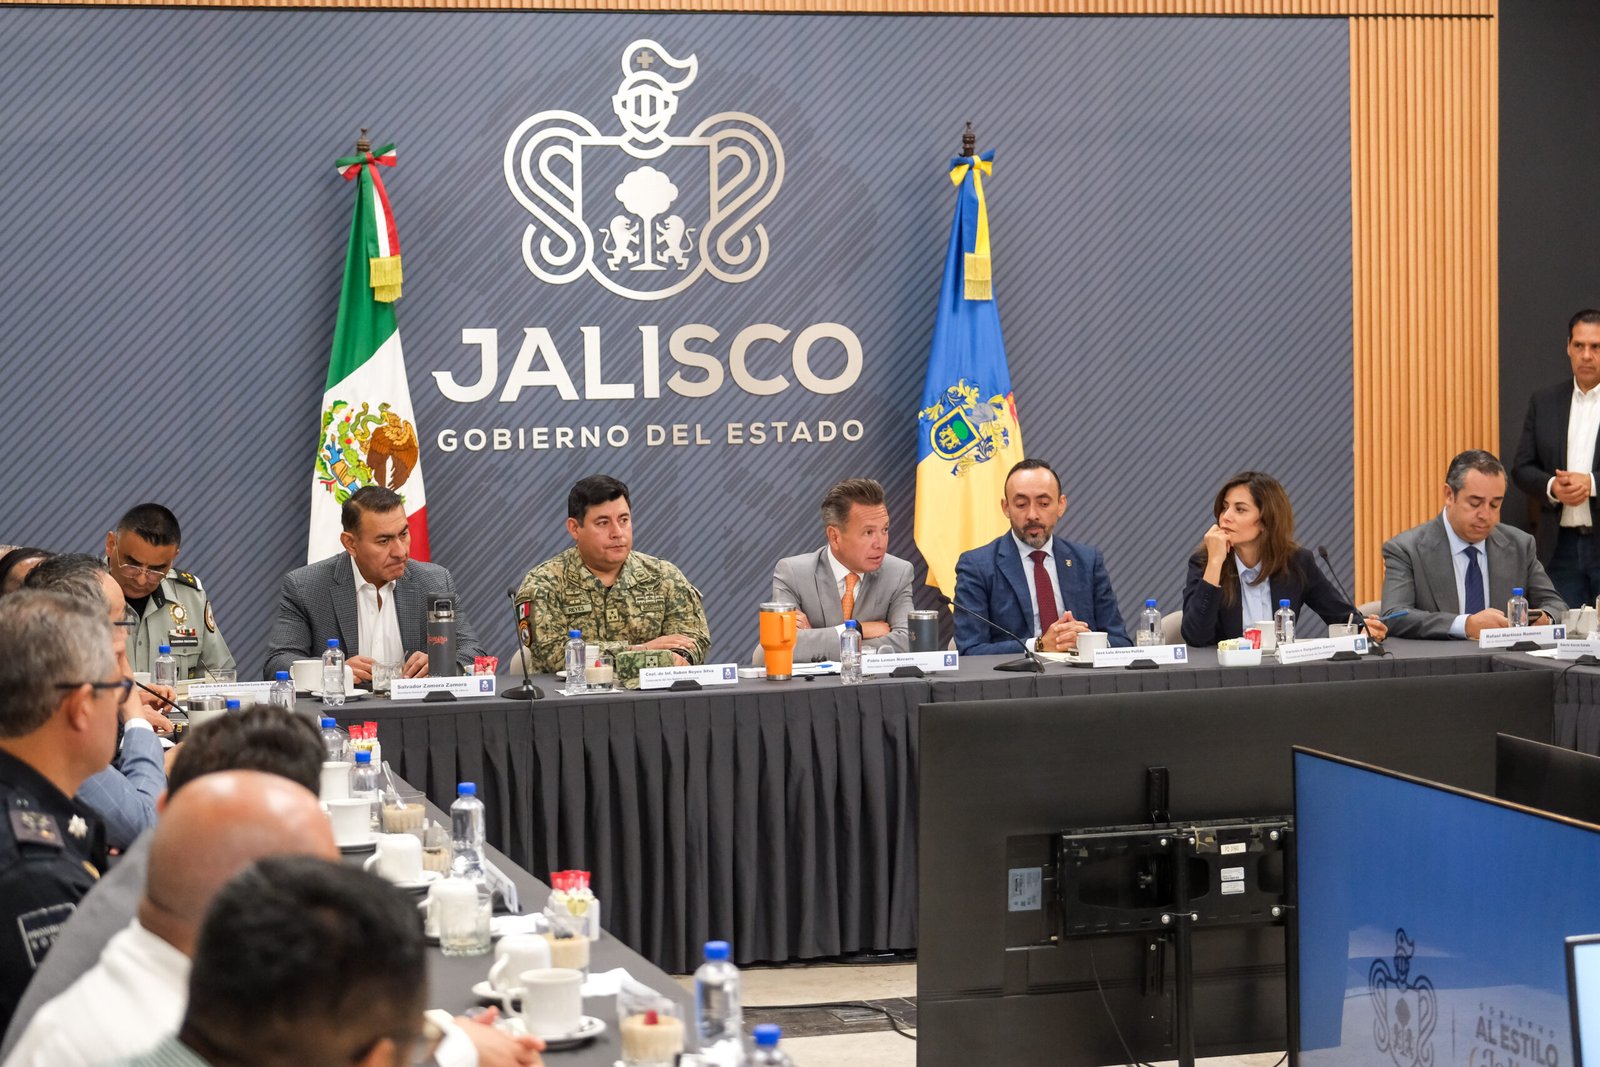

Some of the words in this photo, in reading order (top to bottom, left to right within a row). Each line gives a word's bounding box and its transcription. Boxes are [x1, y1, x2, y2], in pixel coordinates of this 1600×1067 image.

[431, 322, 864, 403] JALISCO
[437, 424, 630, 453] GOBIERNO
[646, 424, 712, 447] DEL
[727, 419, 865, 446] ESTADO
[1475, 1015, 1498, 1046] AL
[1500, 1023, 1559, 1067] ESTILO
